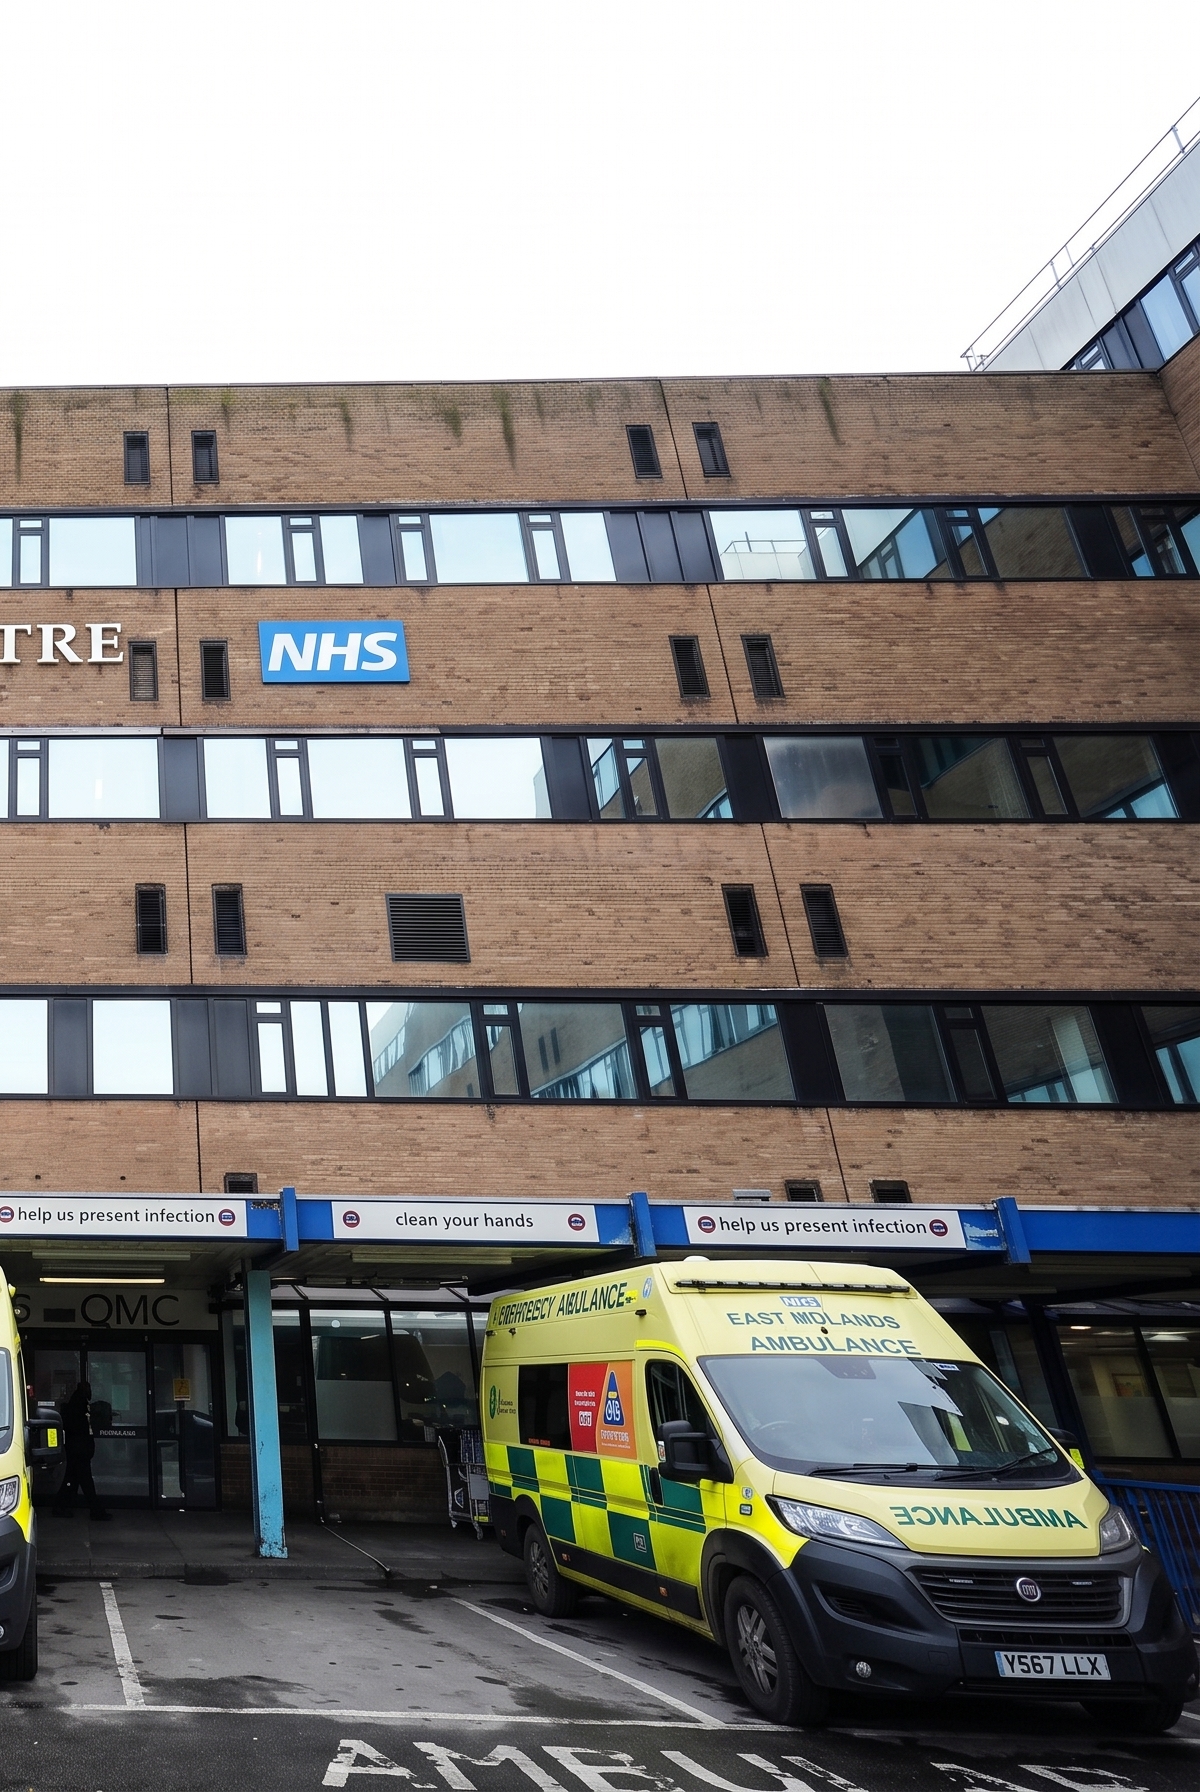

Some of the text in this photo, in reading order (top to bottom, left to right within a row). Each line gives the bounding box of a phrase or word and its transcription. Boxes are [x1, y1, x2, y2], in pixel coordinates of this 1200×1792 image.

[267, 632, 398, 671] NHS
[18, 1206, 215, 1225] help us present infection
[395, 1211, 534, 1231] clean your hands
[718, 1216, 928, 1236] help us present infection
[80, 1293, 180, 1329] QMC
[726, 1312, 785, 1326] EAST
[751, 1336, 922, 1356] AMBULANCE
[1060, 1655, 1103, 1676] LLX
